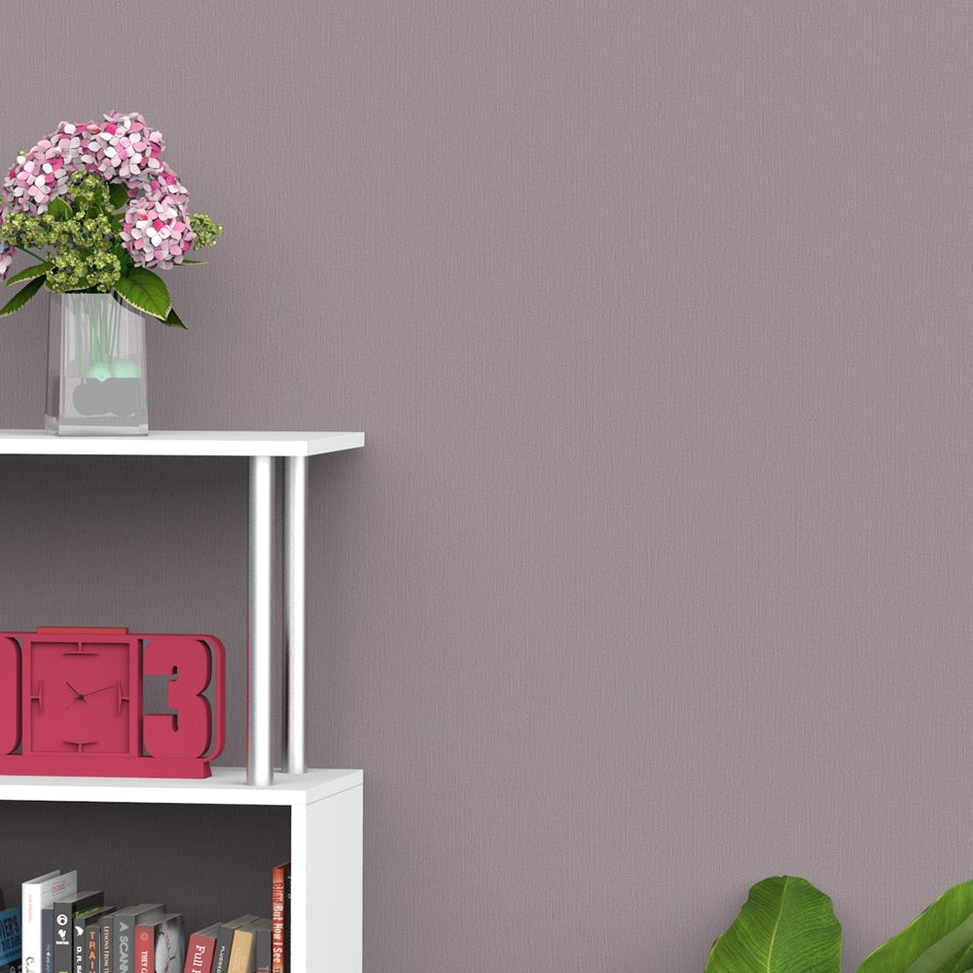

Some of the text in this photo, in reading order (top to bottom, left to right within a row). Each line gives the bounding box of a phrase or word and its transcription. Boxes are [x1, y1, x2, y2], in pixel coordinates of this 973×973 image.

[142, 638, 211, 758] 3
[273, 905, 283, 921] But
[119, 922, 129, 932] A
[273, 923, 283, 939] Now
[76, 946, 82, 954] D.
[193, 945, 206, 967] Full
[273, 947, 283, 963] See
[140, 950, 148, 967] THEY
